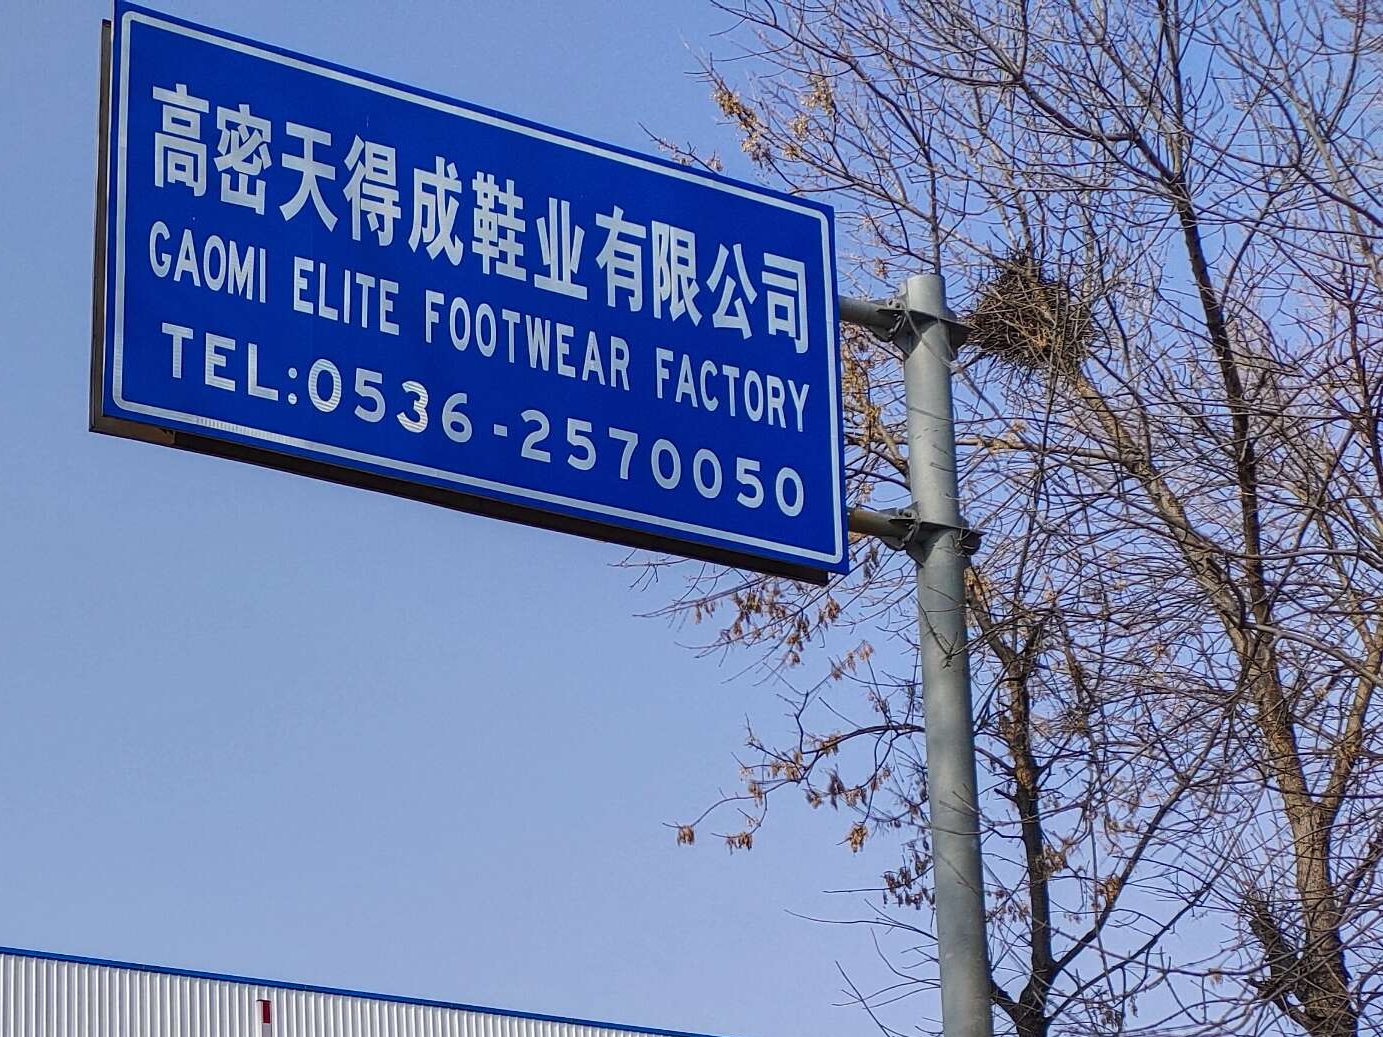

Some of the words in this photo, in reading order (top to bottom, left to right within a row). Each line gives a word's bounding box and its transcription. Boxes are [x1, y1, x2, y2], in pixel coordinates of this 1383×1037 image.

[149, 220, 267, 305] GAOMI
[293, 258, 400, 336] ELITE
[425, 290, 631, 392] FOOTWEAR
[655, 349, 810, 433] FACTORY
[151, 83, 809, 354] 高密天得成鞋业有限公司
